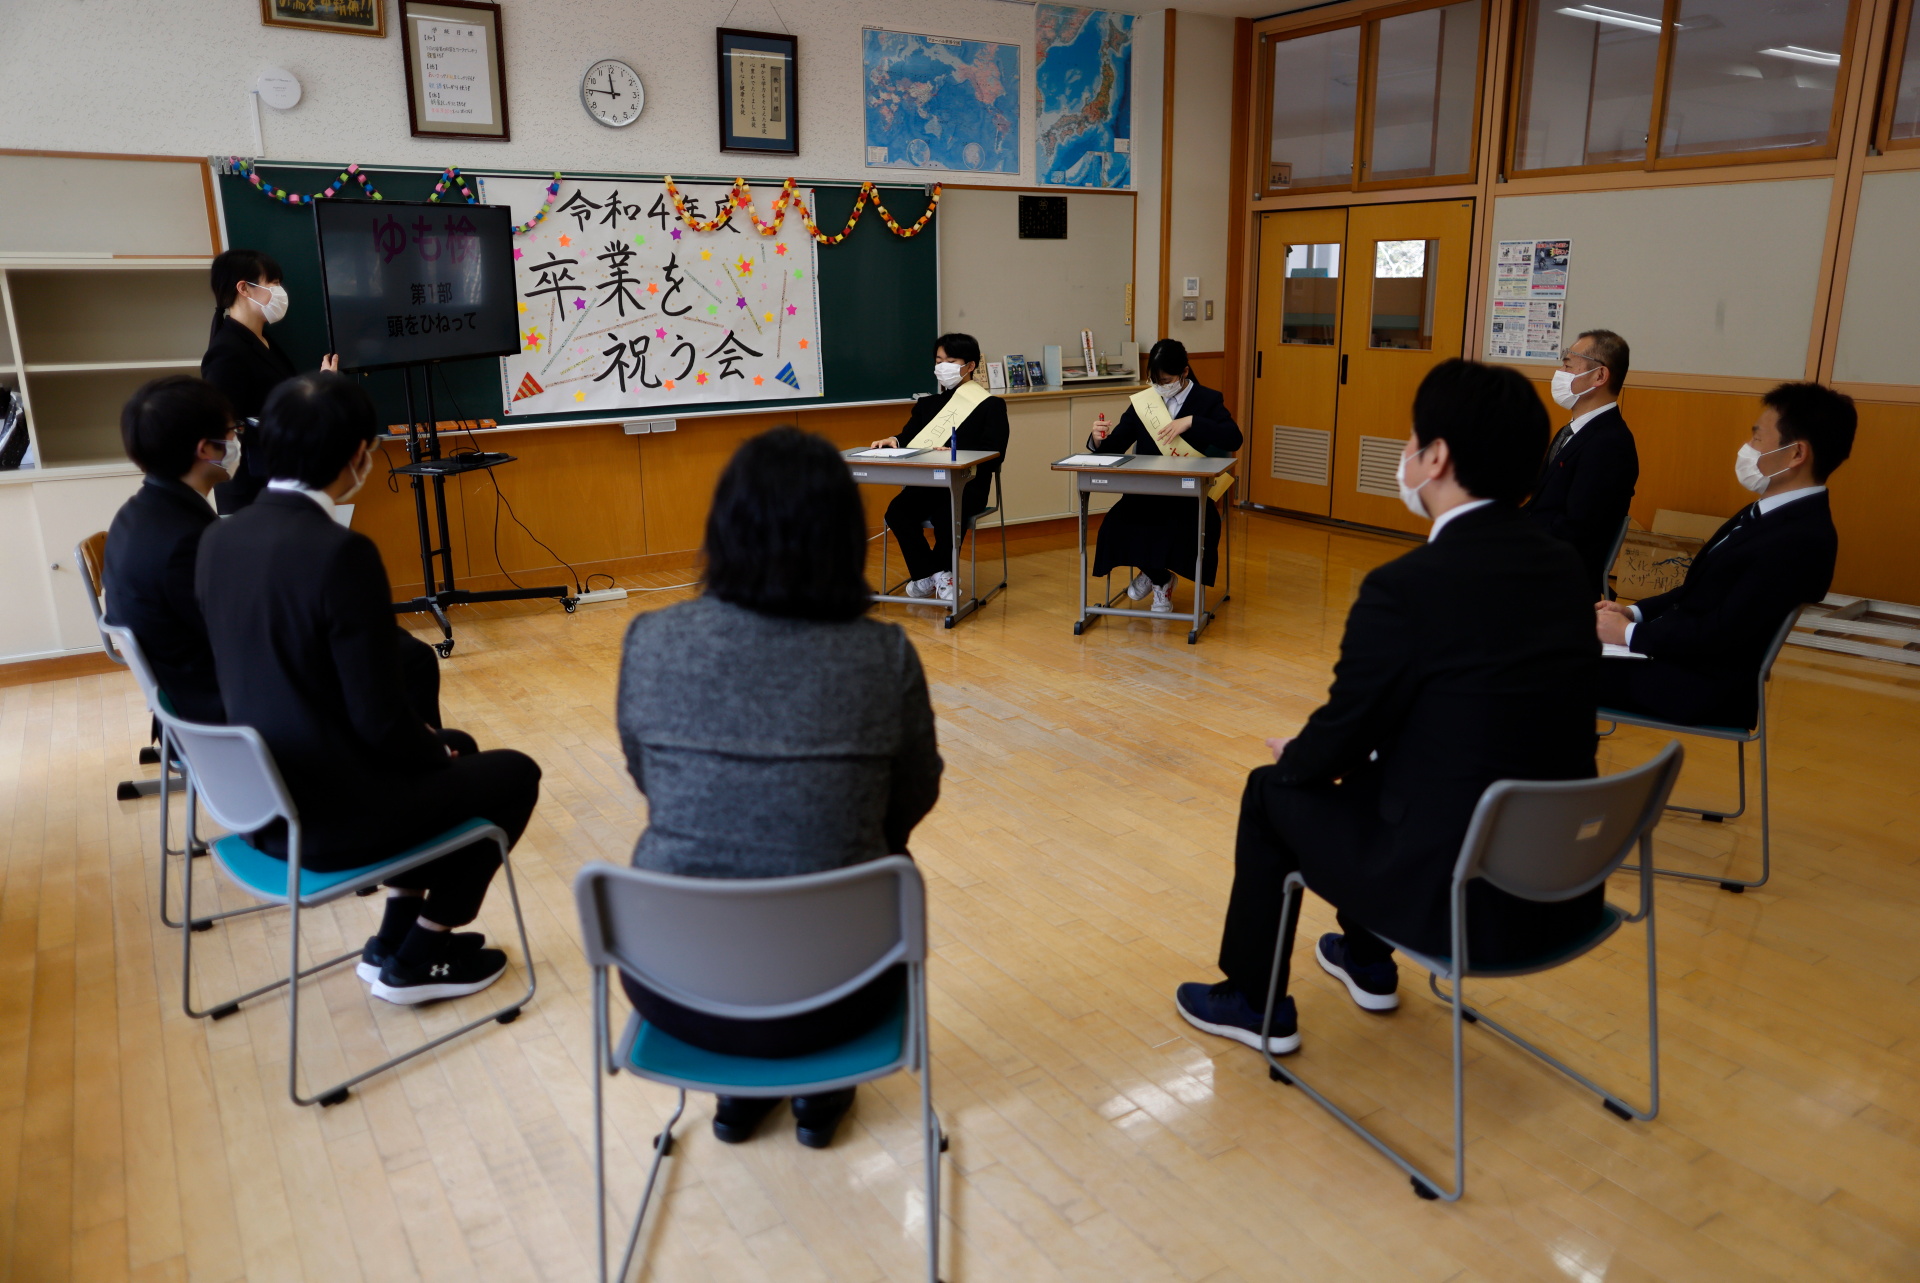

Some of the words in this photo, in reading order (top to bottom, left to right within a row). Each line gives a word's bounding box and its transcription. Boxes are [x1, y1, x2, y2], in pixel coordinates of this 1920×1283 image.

[556, 188, 741, 234] 令和4年度
[372, 213, 480, 265] ゆも検
[410, 281, 453, 306] 第1部
[524, 239, 693, 322] 卒業を
[387, 311, 478, 338] 頭をひねって
[593, 329, 764, 393] 祝う会
